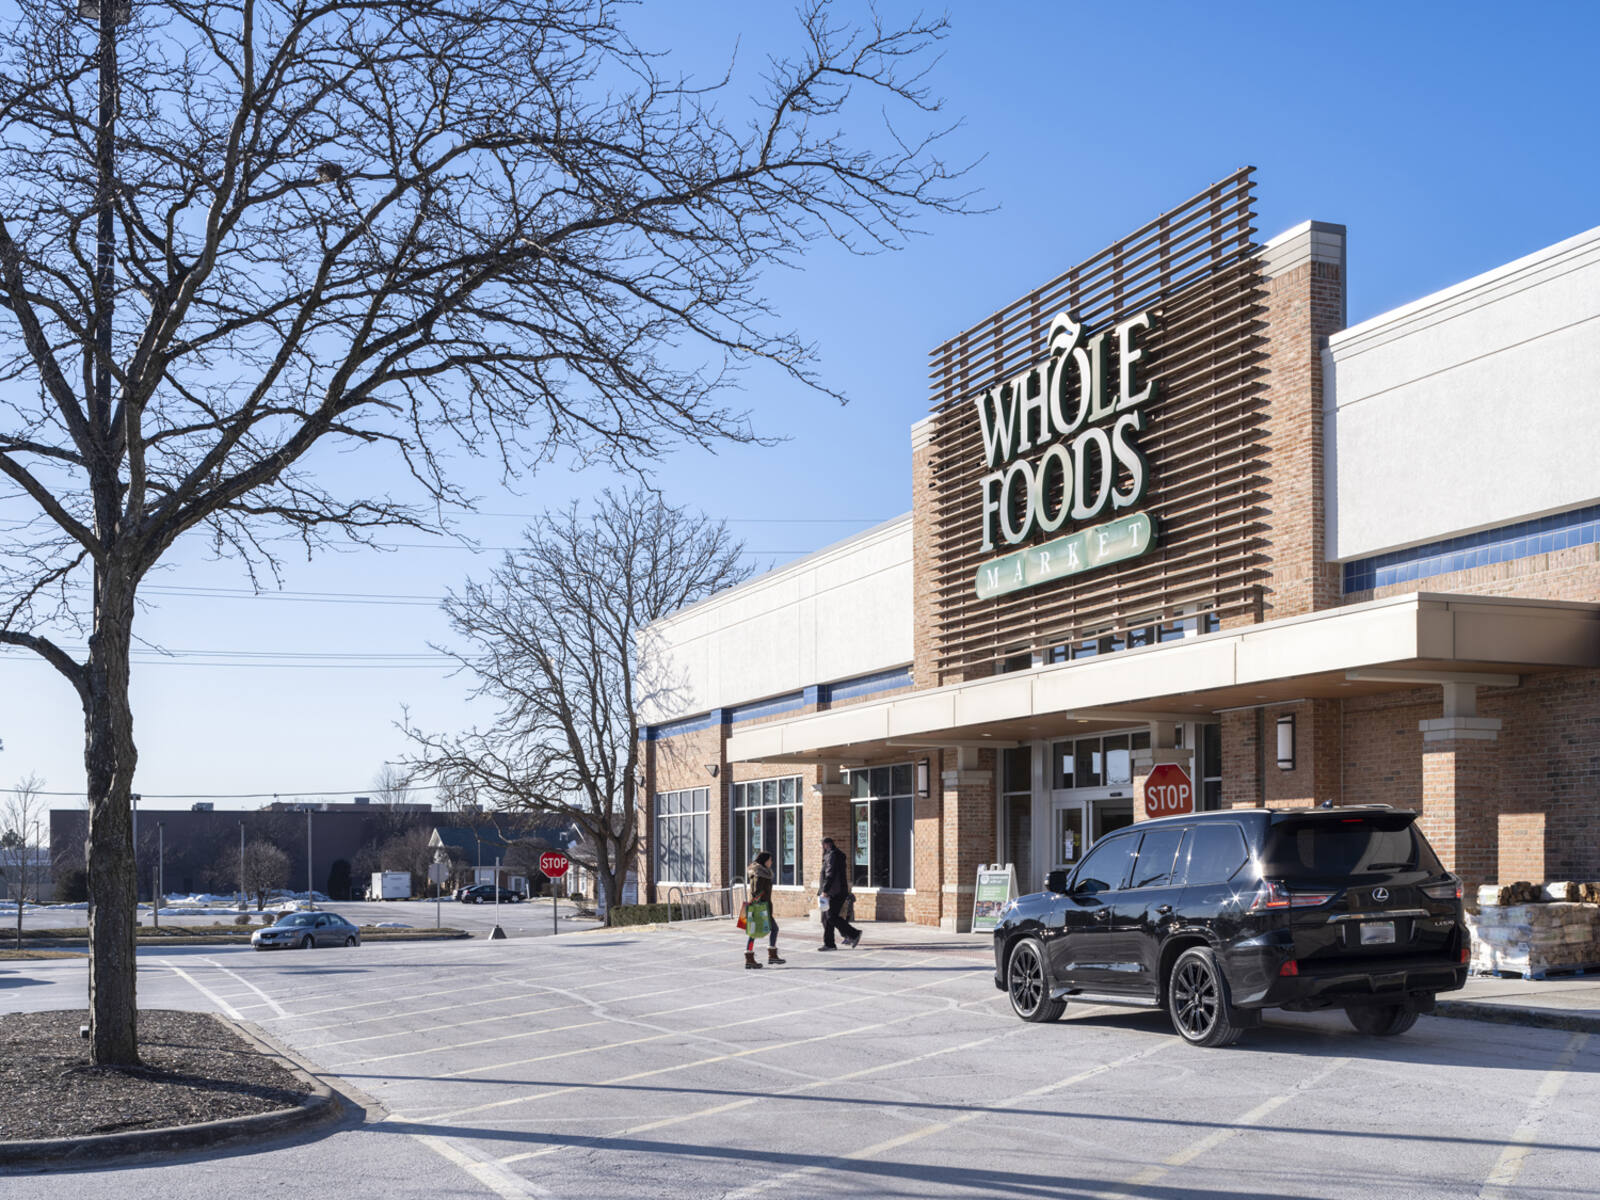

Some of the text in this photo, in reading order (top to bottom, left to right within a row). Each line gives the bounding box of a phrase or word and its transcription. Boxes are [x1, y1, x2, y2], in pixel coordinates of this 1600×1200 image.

[975, 312, 1152, 468] WHOLE
[979, 410, 1143, 553] FOODS
[986, 522, 1142, 591] MARKET
[1147, 784, 1189, 811] STOP
[542, 857, 567, 869] STOP
